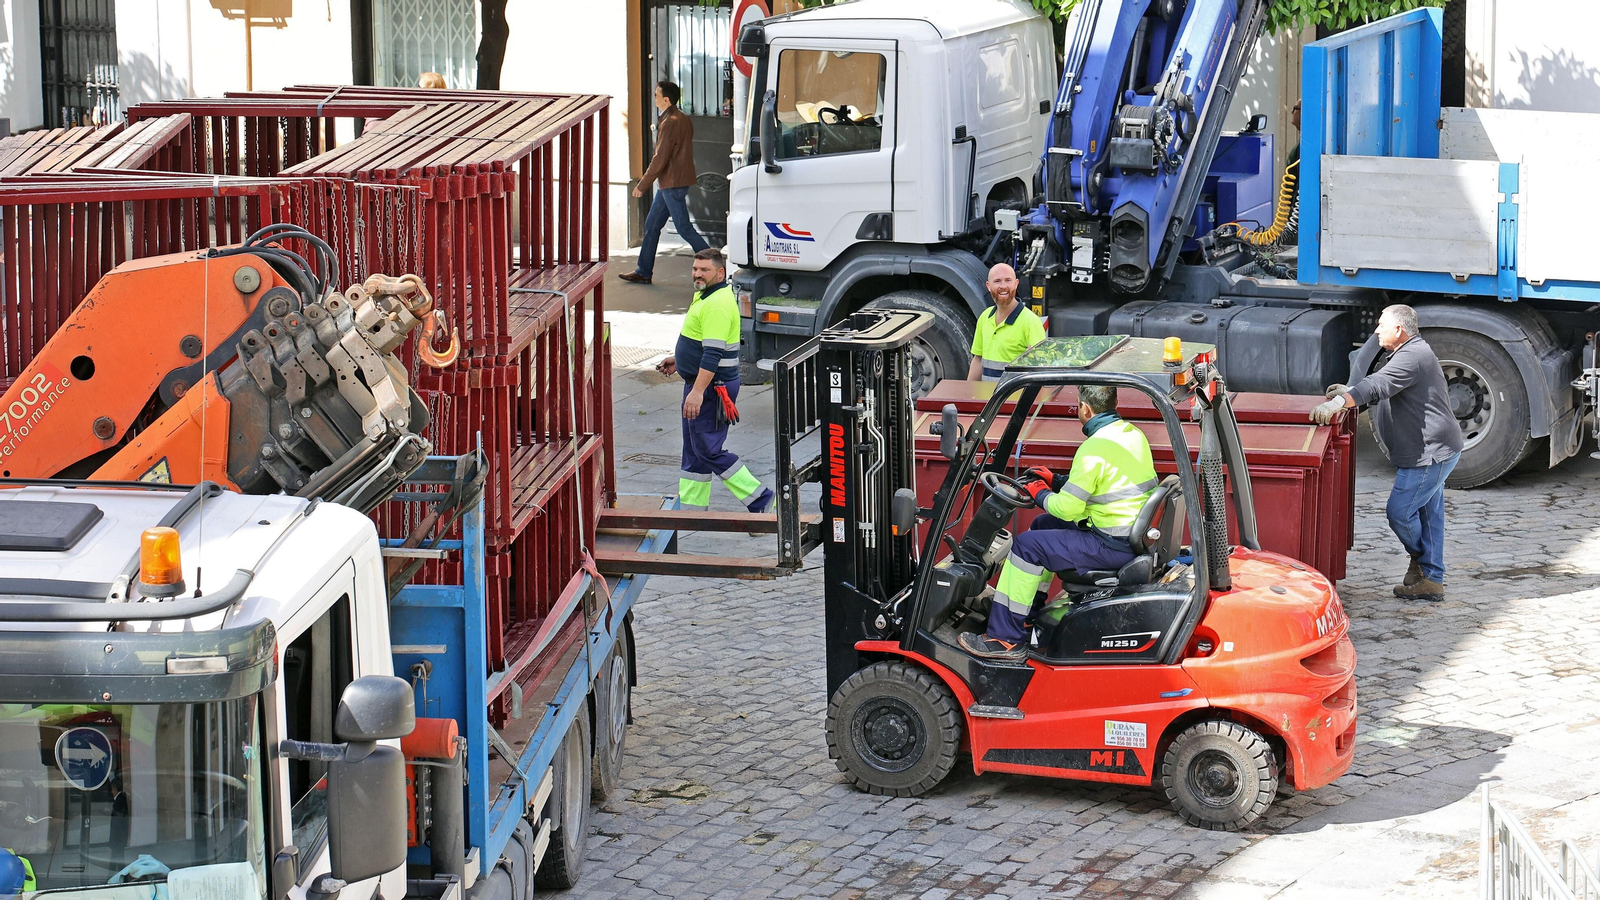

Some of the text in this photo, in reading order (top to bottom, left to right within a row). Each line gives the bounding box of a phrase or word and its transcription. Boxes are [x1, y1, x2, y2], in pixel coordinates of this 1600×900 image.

[0, 373, 53, 444] 7002
[829, 423, 846, 507] MANITOU
[1107, 729, 1145, 737] ALQUILERES
[1090, 751, 1125, 767] MI
